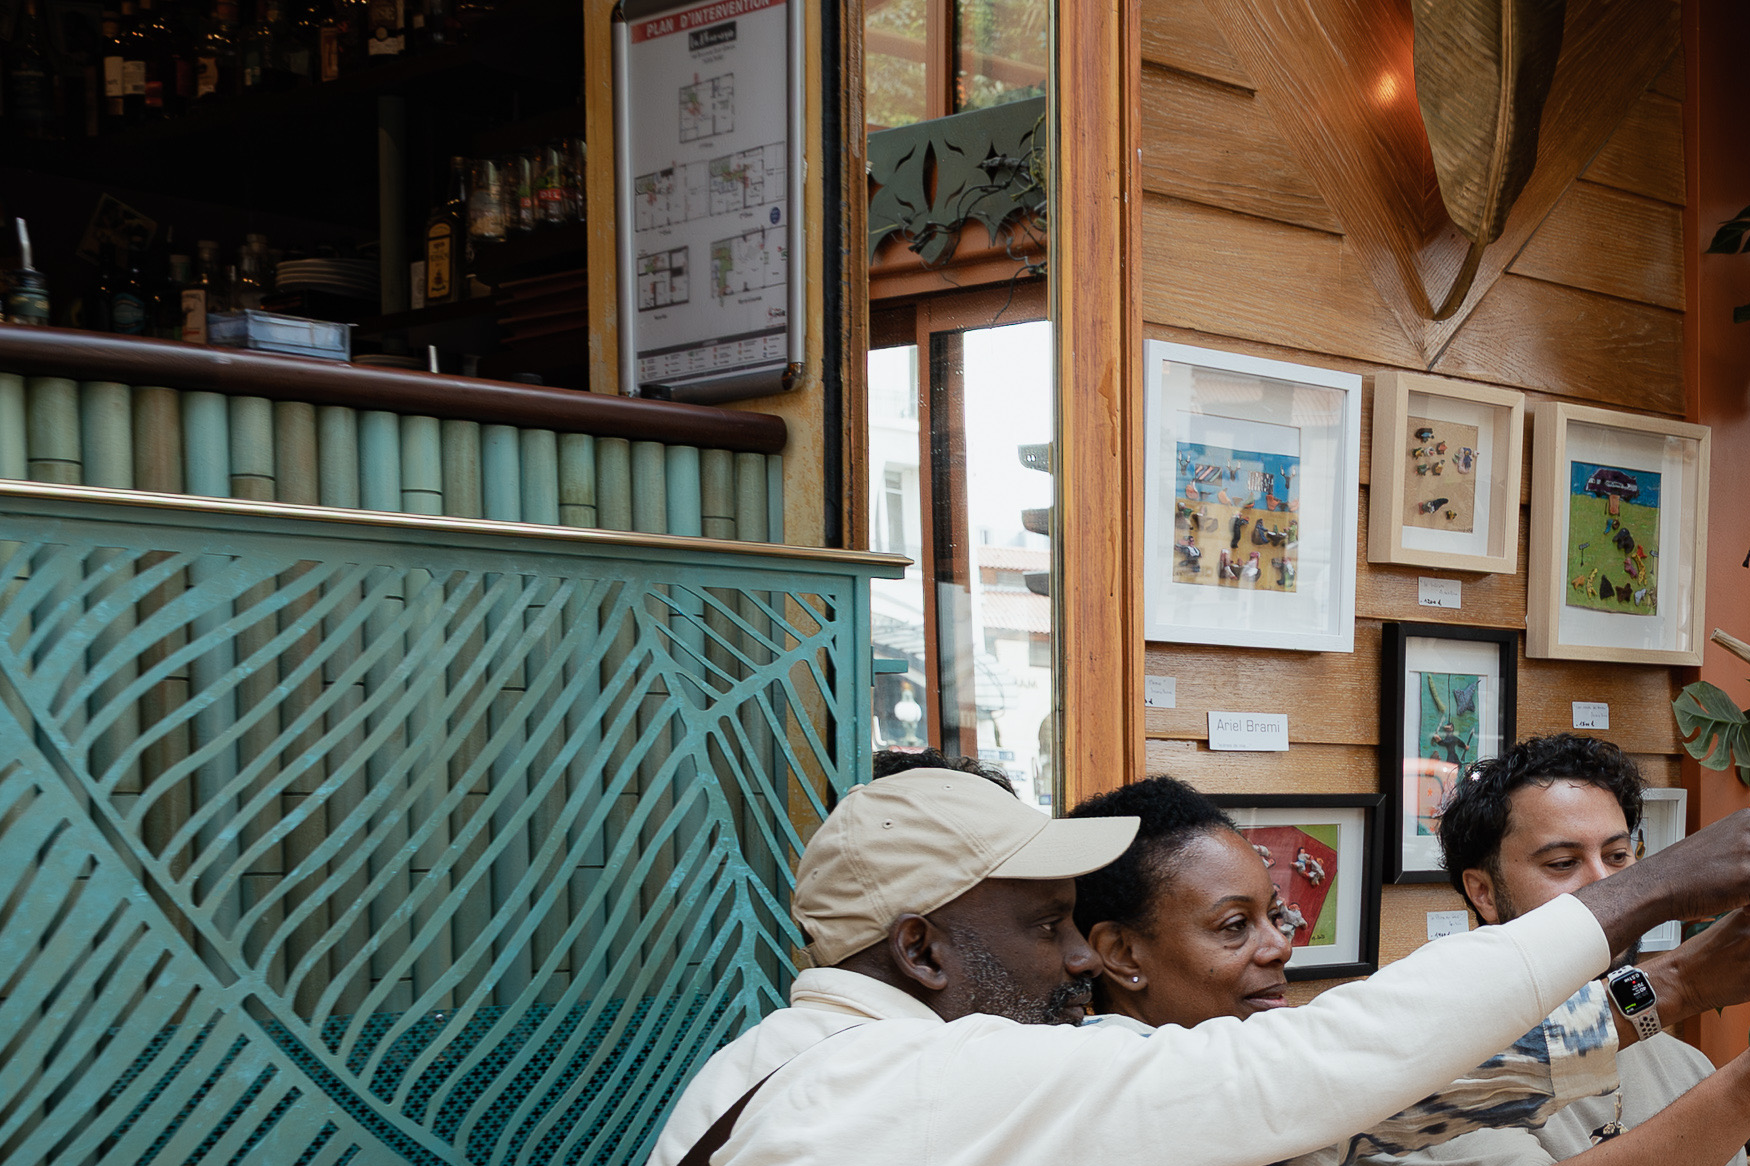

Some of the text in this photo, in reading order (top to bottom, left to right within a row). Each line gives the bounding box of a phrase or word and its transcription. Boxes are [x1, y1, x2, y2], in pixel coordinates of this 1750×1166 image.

[646, 18, 674, 38] PLAN
[1216, 718, 1280, 733] Ariel Brami
